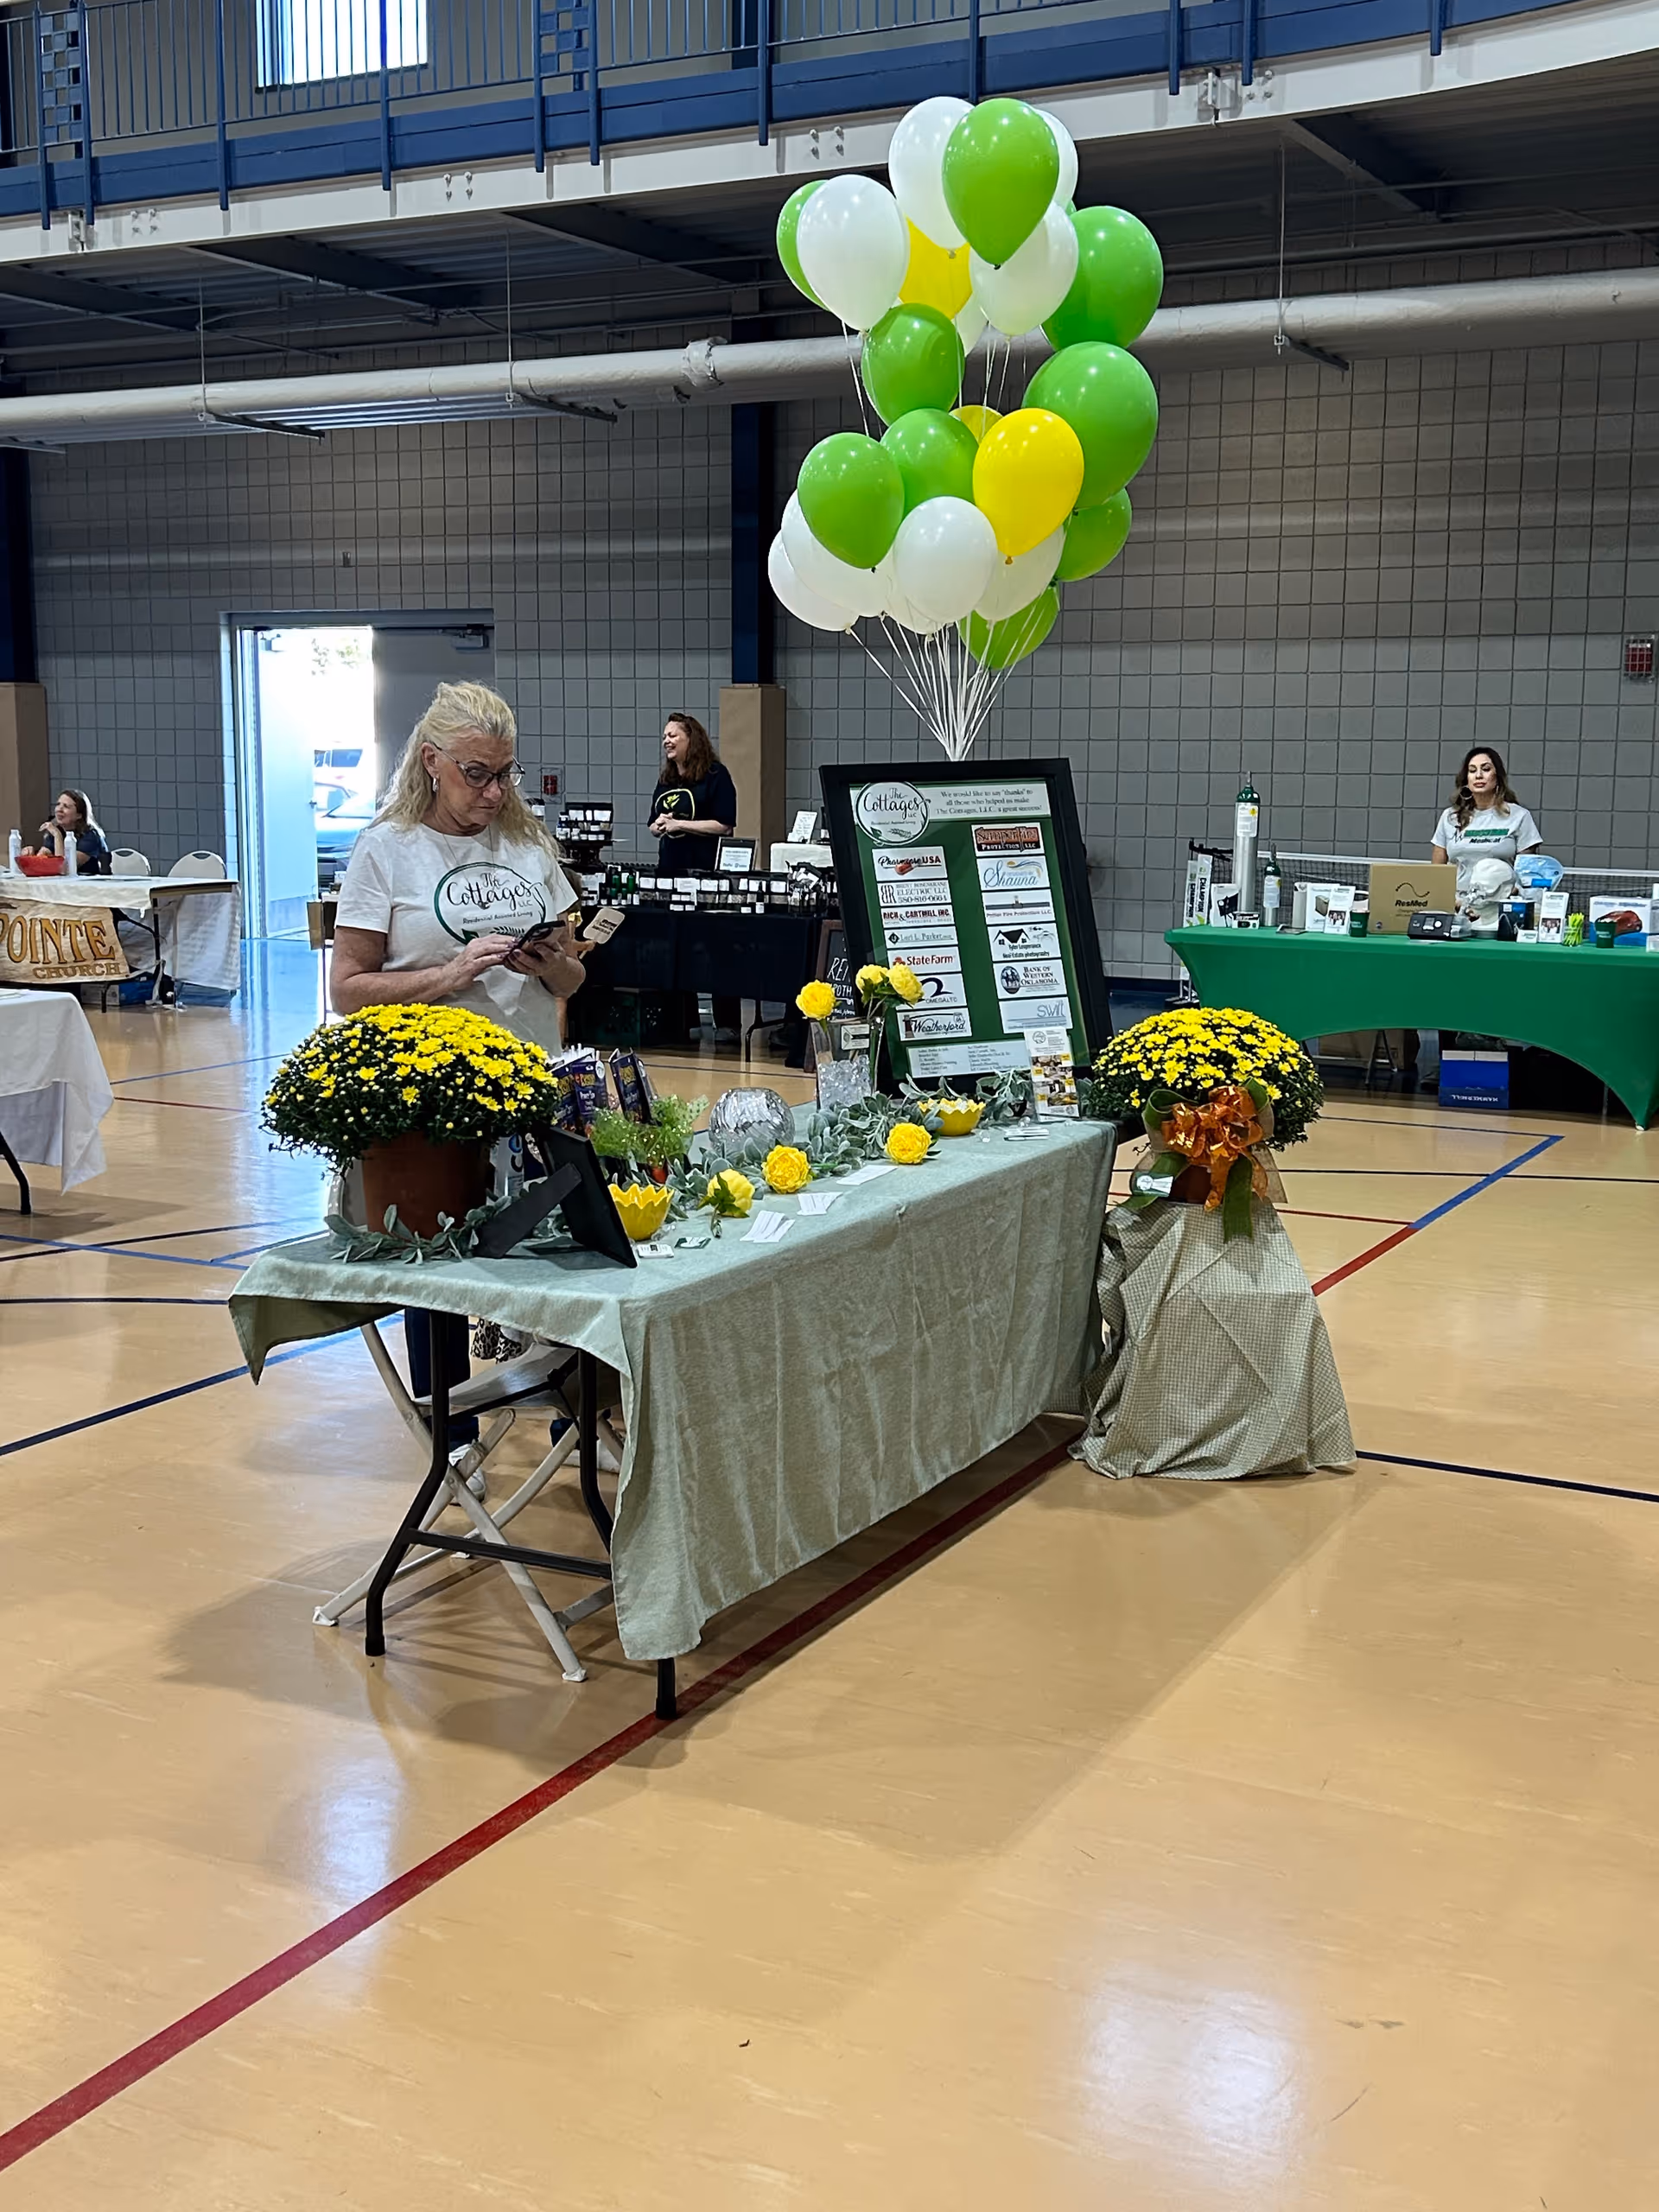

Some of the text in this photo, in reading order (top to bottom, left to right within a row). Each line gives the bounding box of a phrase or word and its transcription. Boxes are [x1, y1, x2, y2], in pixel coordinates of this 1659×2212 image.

[889, 787, 908, 798] The
[864, 792, 920, 819] Cottages
[922, 855, 941, 864] USA
[480, 873, 509, 887] The
[984, 860, 1038, 888] Shauna
[447, 881, 531, 911] Cottages
[33, 963, 121, 979] CHURCH
[913, 1018, 965, 1033] Weatherford
